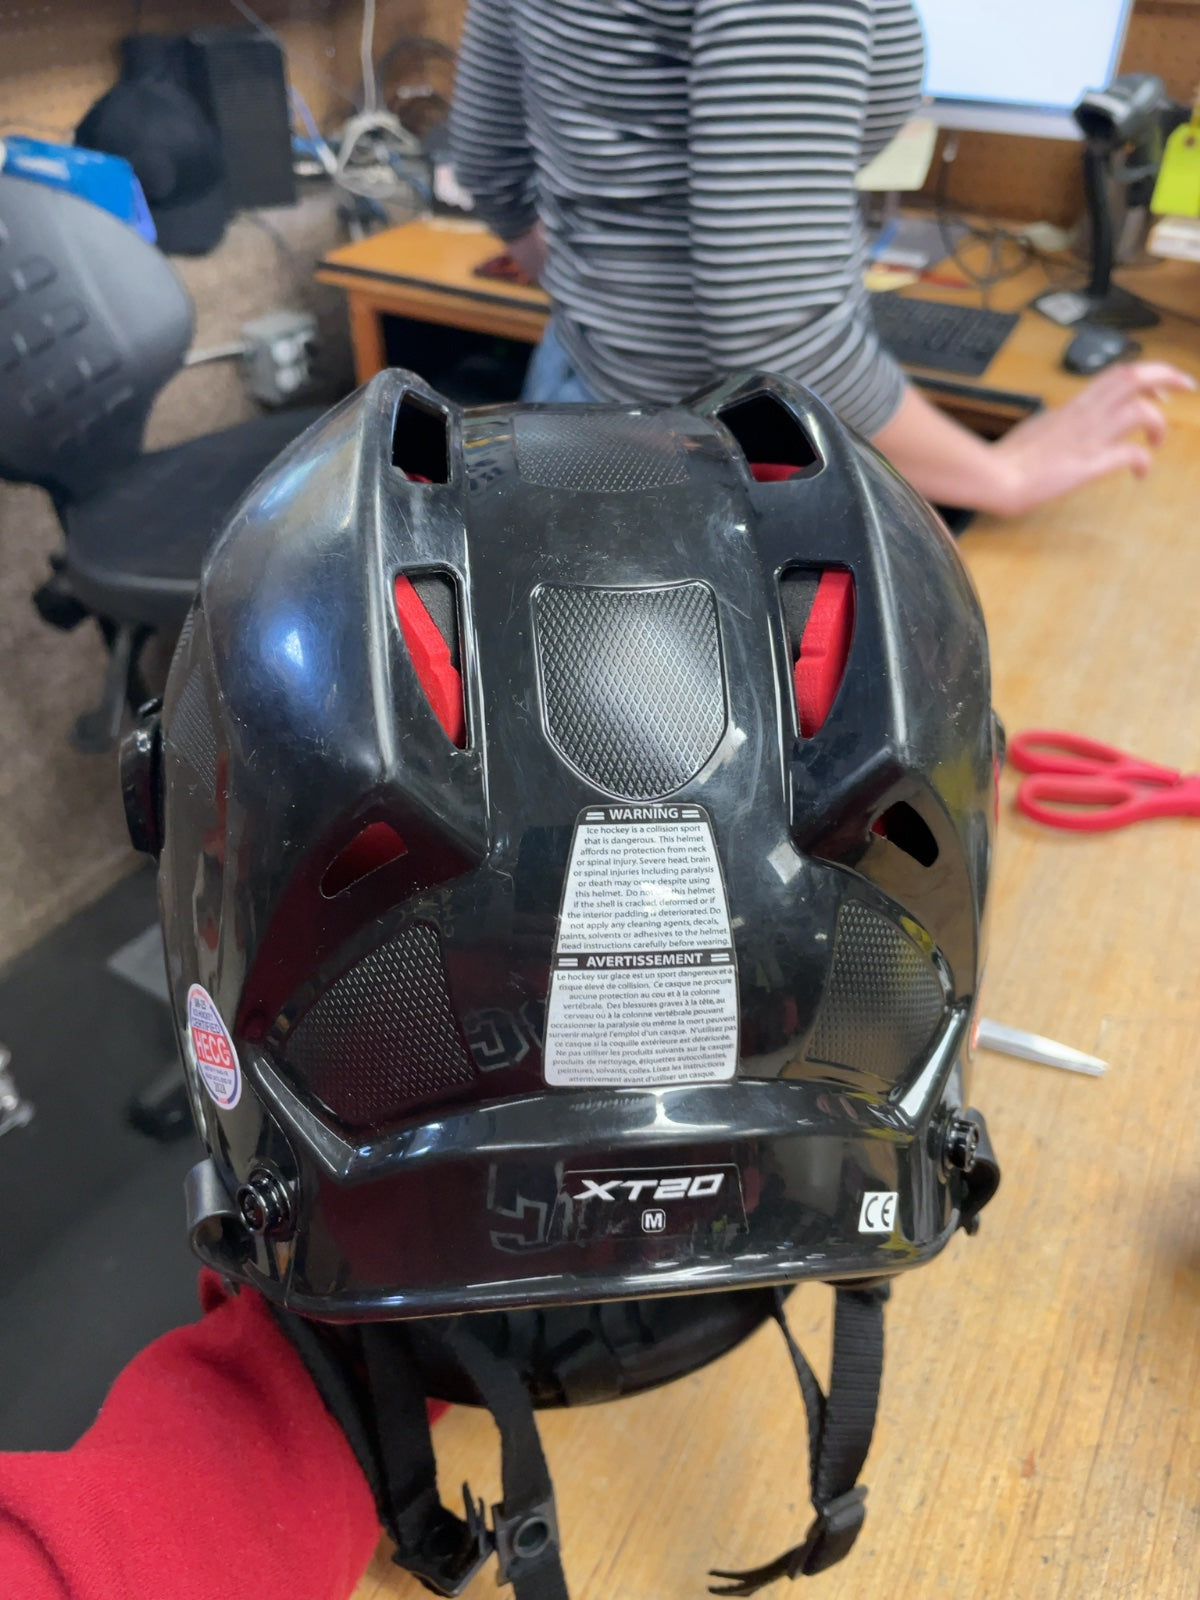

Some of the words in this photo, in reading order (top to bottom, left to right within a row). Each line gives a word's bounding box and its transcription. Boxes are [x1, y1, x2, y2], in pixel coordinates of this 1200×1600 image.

[609, 808, 678, 819] WARNING
[586, 826, 598, 834] Ice
[600, 826, 629, 836] hockey
[646, 825, 678, 833] collision
[680, 824, 700, 834] sport
[584, 836, 600, 844] that
[659, 836, 674, 844] This
[676, 835, 703, 844] helmet
[580, 847, 608, 855] affords
[623, 846, 665, 856] protection
[667, 846, 686, 854] from
[687, 845, 706, 854] neck
[587, 857, 611, 867] spinal
[639, 856, 666, 865] Severe
[690, 855, 710, 864] brain
[584, 868, 608, 878] spinal
[610, 868, 639, 878] injuries
[641, 867, 678, 877] including
[680, 866, 714, 876] paralysis
[588, 879, 612, 887] death
[614, 880, 631, 888] may
[657, 877, 687, 887] despite
[688, 876, 710, 886] using
[575, 889, 590, 897] this
[639, 888, 653, 896] not
[671, 887, 685, 896] this
[687, 886, 715, 895] helmet
[580, 900, 594, 908] the
[596, 900, 615, 908] shell
[567, 911, 581, 919] the
[582, 910, 612, 919] interior
[614, 909, 648, 920] padding
[570, 921, 584, 930] not
[586, 921, 608, 931] apply
[610, 922, 625, 931] any
[626, 920, 661, 930] cleaning
[588, 931, 621, 940] solvents
[633, 930, 672, 939] adhesives
[684, 929, 698, 937] the
[561, 942, 582, 950] Read
[583, 941, 631, 950] instructions
[633, 940, 667, 950] carefully
[668, 939, 694, 948] before
[586, 954, 702, 966] AVERTISSEMENT
[567, 973, 595, 983] hockey
[610, 972, 630, 982] glace
[632, 972, 643, 980] est
[657, 970, 676, 981] sport
[678, 969, 717, 980] dangereux
[584, 982, 604, 990] élevé
[664, 981, 691, 990] casque
[703, 978, 732, 988] procure
[598, 992, 638, 1002] protection
[690, 987, 720, 996] colonne
[606, 1001, 621, 1010] Des
[622, 1000, 657, 1009] blessures
[658, 1001, 683, 1010] graves
[622, 1010, 652, 1019] colonne
[654, 1008, 692, 1018] vertébrale
[693, 1006, 724, 1017] pouvant
[550, 1021, 595, 1029] occasionner
[606, 1020, 639, 1030] paralysie
[652, 1018, 676, 1027] même
[686, 1017, 704, 1026] mort
[705, 1015, 736, 1026] peuvent
[194, 1030, 231, 1066] HECC
[572, 1173, 725, 1201] XT20
[865, 1195, 893, 1228] CE
[645, 1212, 663, 1229] M
